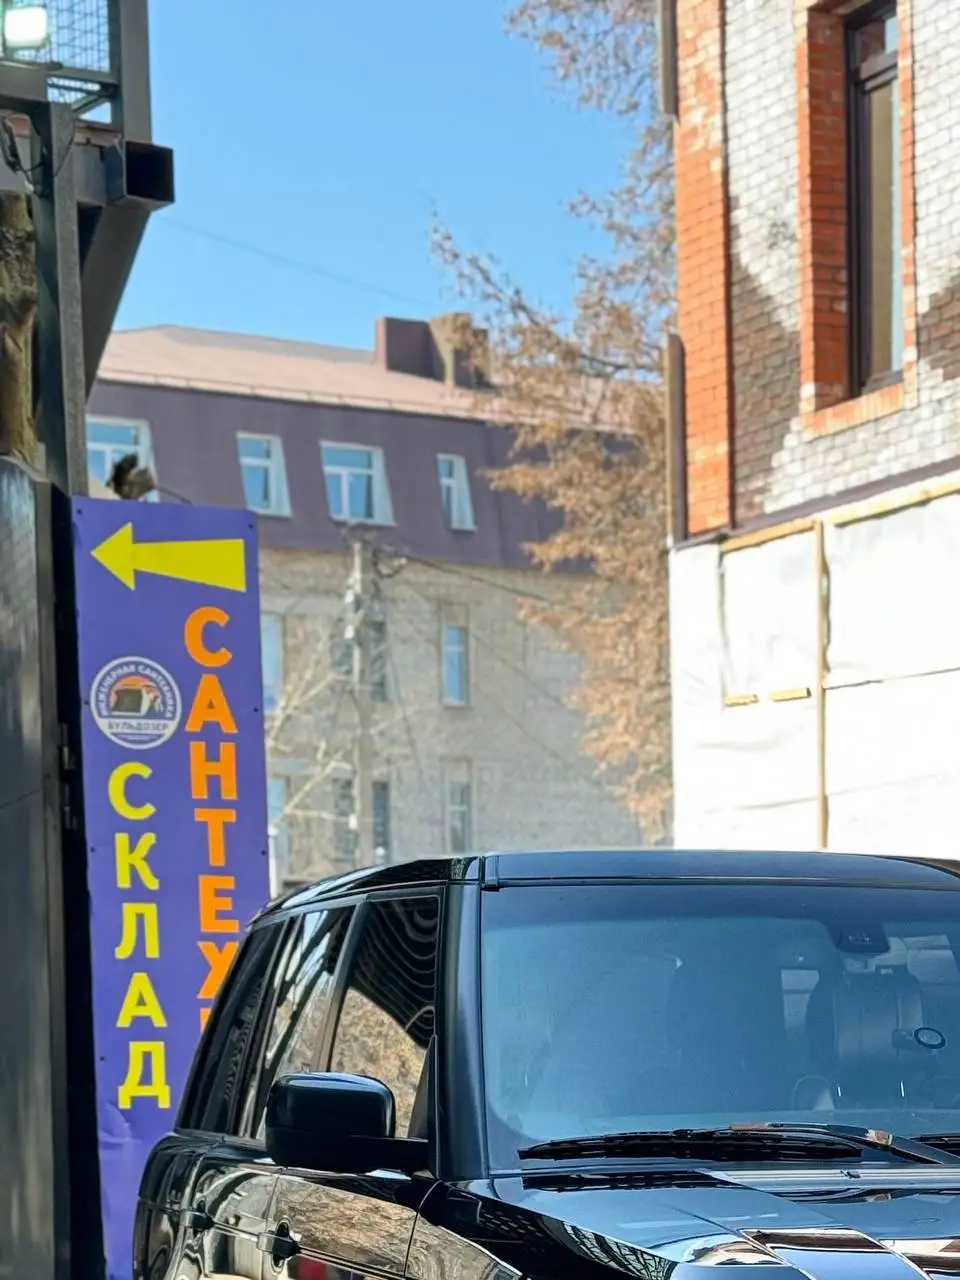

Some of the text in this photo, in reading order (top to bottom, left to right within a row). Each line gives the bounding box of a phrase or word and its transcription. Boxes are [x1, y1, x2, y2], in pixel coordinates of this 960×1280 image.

[108, 721, 169, 731] БУЛЬДОЗЕР
[185, 606, 239, 1032] САНТЕХ
[108, 762, 170, 1109] СКЛАД
